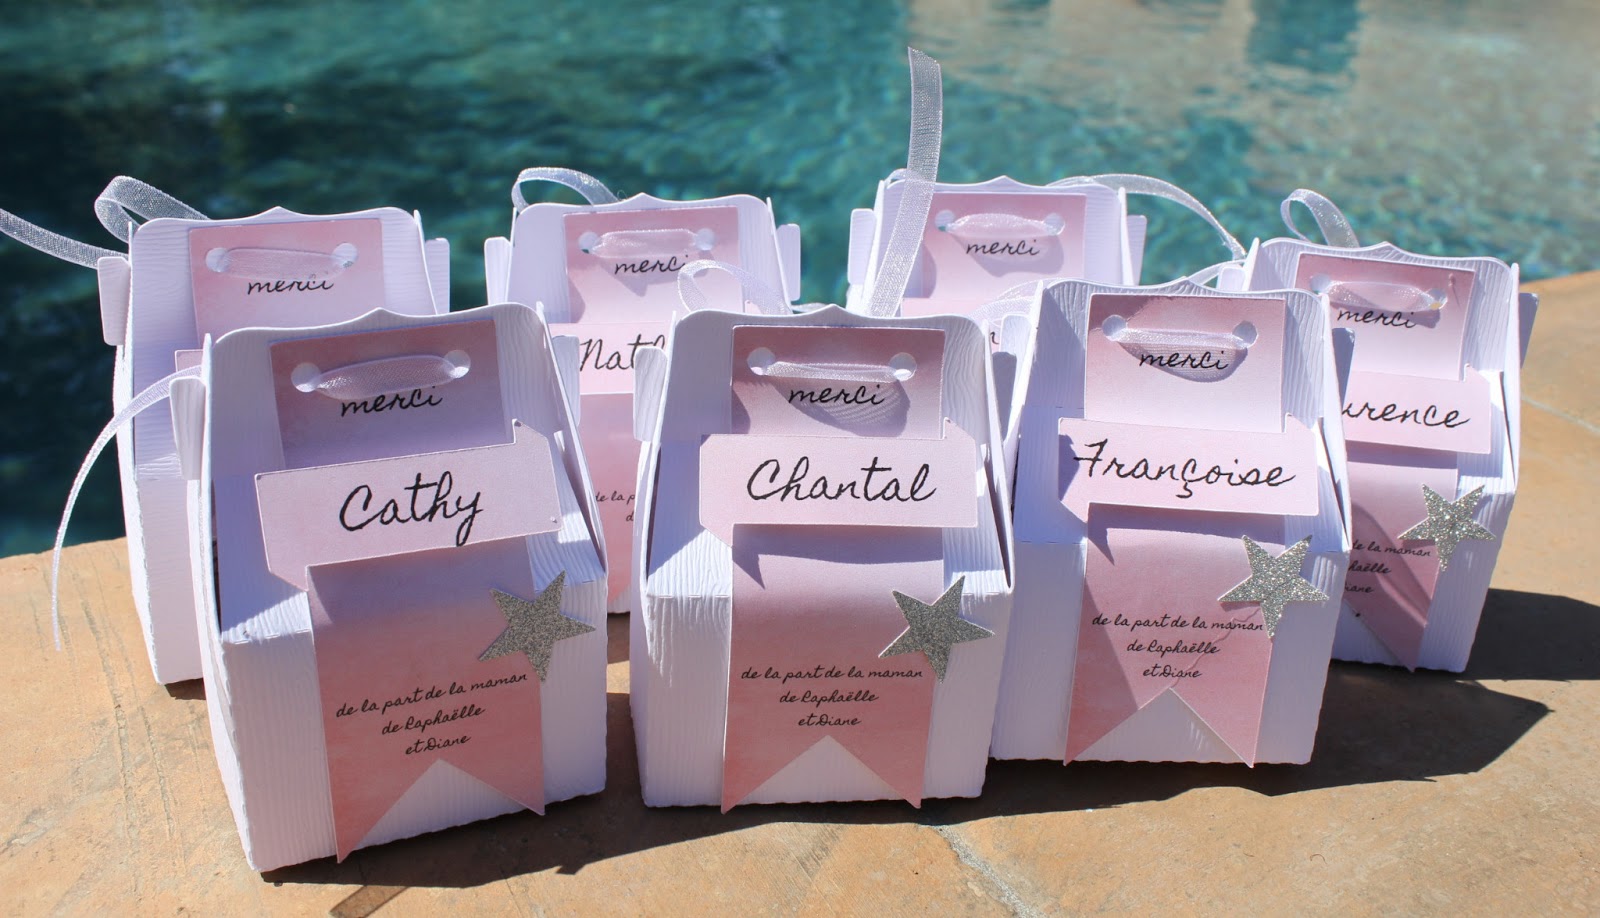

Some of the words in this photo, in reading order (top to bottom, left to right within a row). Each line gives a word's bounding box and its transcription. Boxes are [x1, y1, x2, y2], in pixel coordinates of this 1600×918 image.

[966, 239, 1040, 257] merci
[1336, 309, 1417, 329] merci
[1139, 350, 1229, 370] merci
[340, 386, 443, 417] merci
[788, 383, 886, 405] merci
[1073, 438, 1296, 499] Françoise
[747, 456, 937, 502] Chantal
[339, 471, 484, 547] Cathy
[1384, 546, 1431, 557] maman
[1092, 613, 1111, 626] de
[1114, 614, 1130, 627] la
[1132, 614, 1169, 631] part
[1171, 615, 1189, 627] de
[1192, 616, 1206, 629] la
[1211, 621, 1263, 631] maman
[1127, 640, 1146, 652] de
[741, 667, 761, 679] de
[764, 667, 781, 679] la
[782, 665, 824, 684] part
[825, 666, 845, 678] de
[848, 666, 864, 678] la
[868, 668, 923, 678] maman
[336, 703, 358, 717] de
[361, 699, 379, 713] la
[382, 687, 423, 714] part
[425, 685, 446, 699] de
[449, 681, 465, 695] la
[471, 674, 528, 691] maman
[779, 691, 800, 703] de
[382, 720, 403, 735] de
